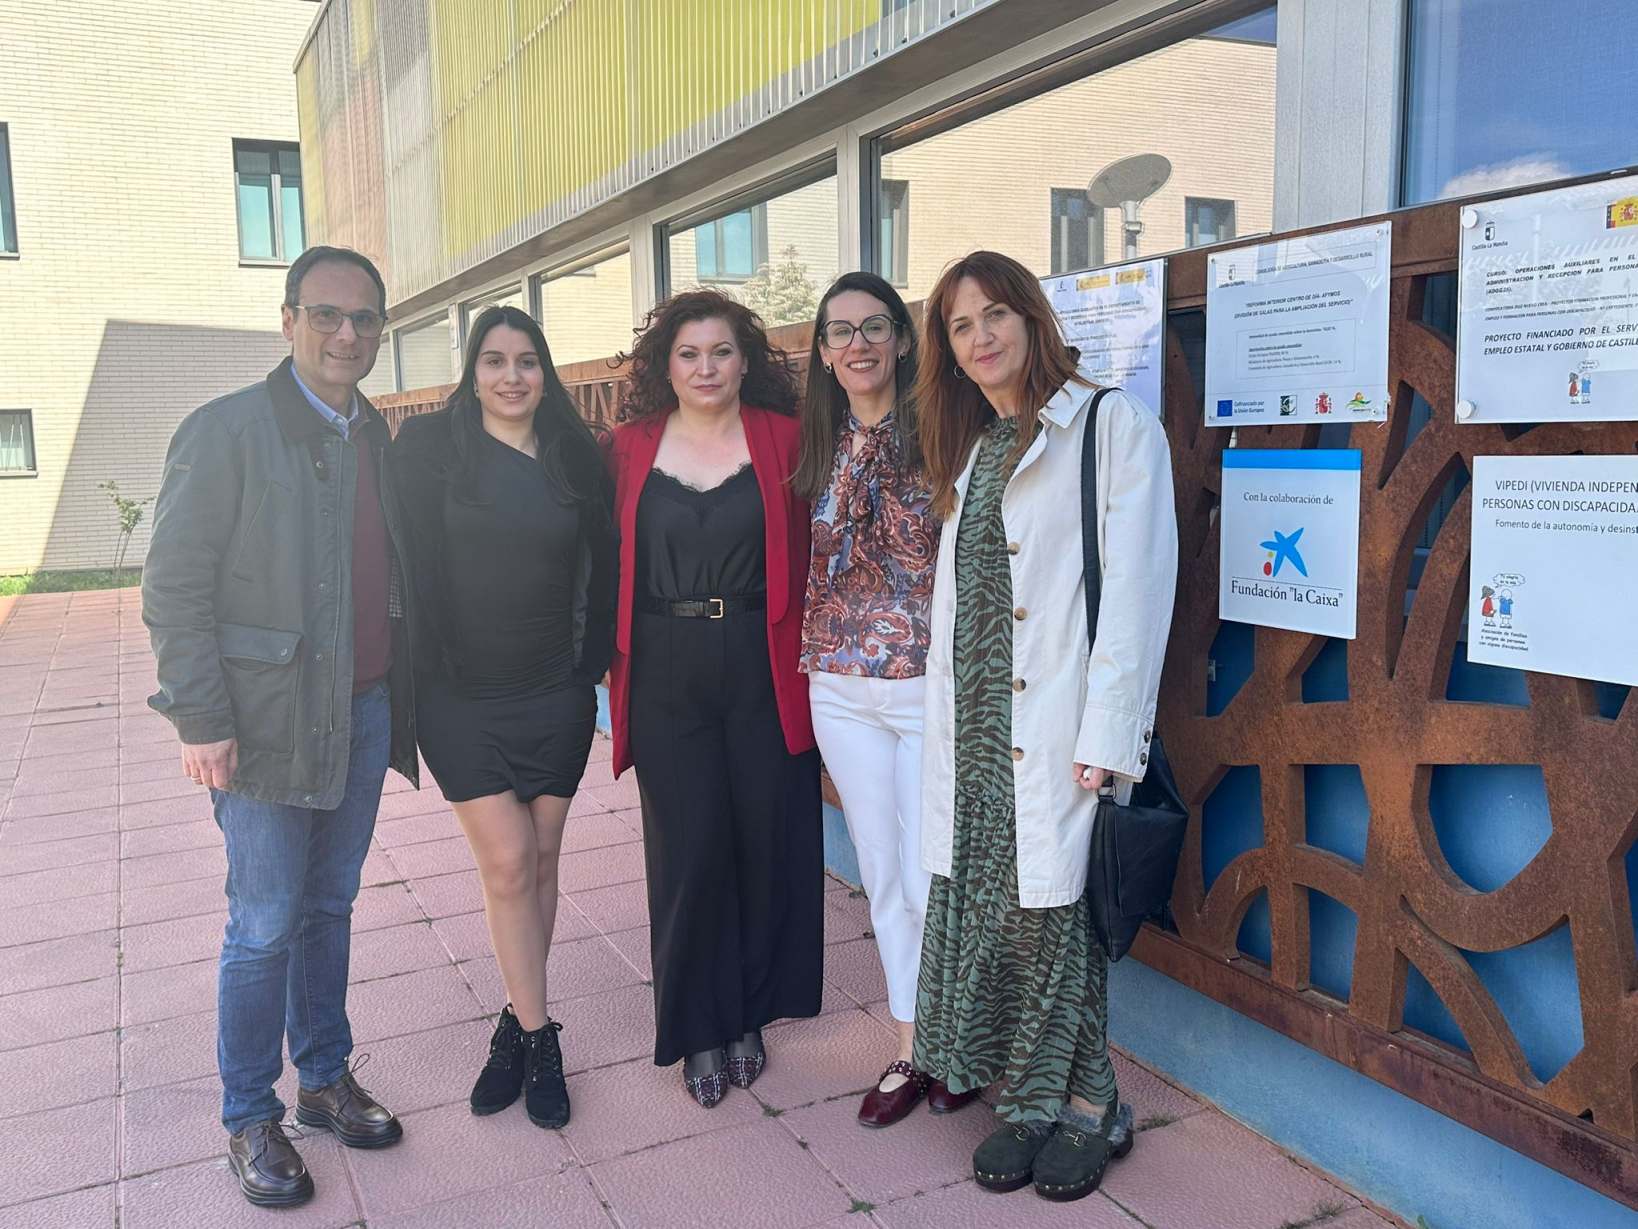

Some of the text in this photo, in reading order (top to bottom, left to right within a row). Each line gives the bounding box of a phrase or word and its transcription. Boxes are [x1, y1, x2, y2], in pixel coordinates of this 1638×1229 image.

[1515, 264, 1555, 274] OPERACIONES
[1564, 259, 1600, 268] AUXILIARES
[1586, 267, 1604, 275] PARA
[1287, 295, 1304, 303] CENTRO
[1484, 331, 1522, 343] PROYECTO
[1526, 328, 1574, 340] FINANCIADO
[1579, 326, 1596, 336] POR
[1601, 326, 1610, 334] EL
[1484, 346, 1513, 355] EMPLEO
[1514, 343, 1544, 354] ESTATAL
[1547, 343, 1552, 351] Y
[1553, 340, 1594, 351] GOBIERNO
[1595, 339, 1607, 348] DE
[1495, 480, 1638, 493] VIPEDI (VIVIENDA INDEPEN
[1243, 491, 1334, 505] Con la colaboración de
[1482, 498, 1638, 513] PERSONAS CON DISCAPACIDA
[1495, 519, 1530, 529] Fomento
[1531, 520, 1542, 530] de
[1543, 521, 1551, 530] la
[1552, 522, 1598, 532] autonomía
[1600, 525, 1606, 535] y
[1231, 579, 1344, 608] Fundación "la Caixa"
